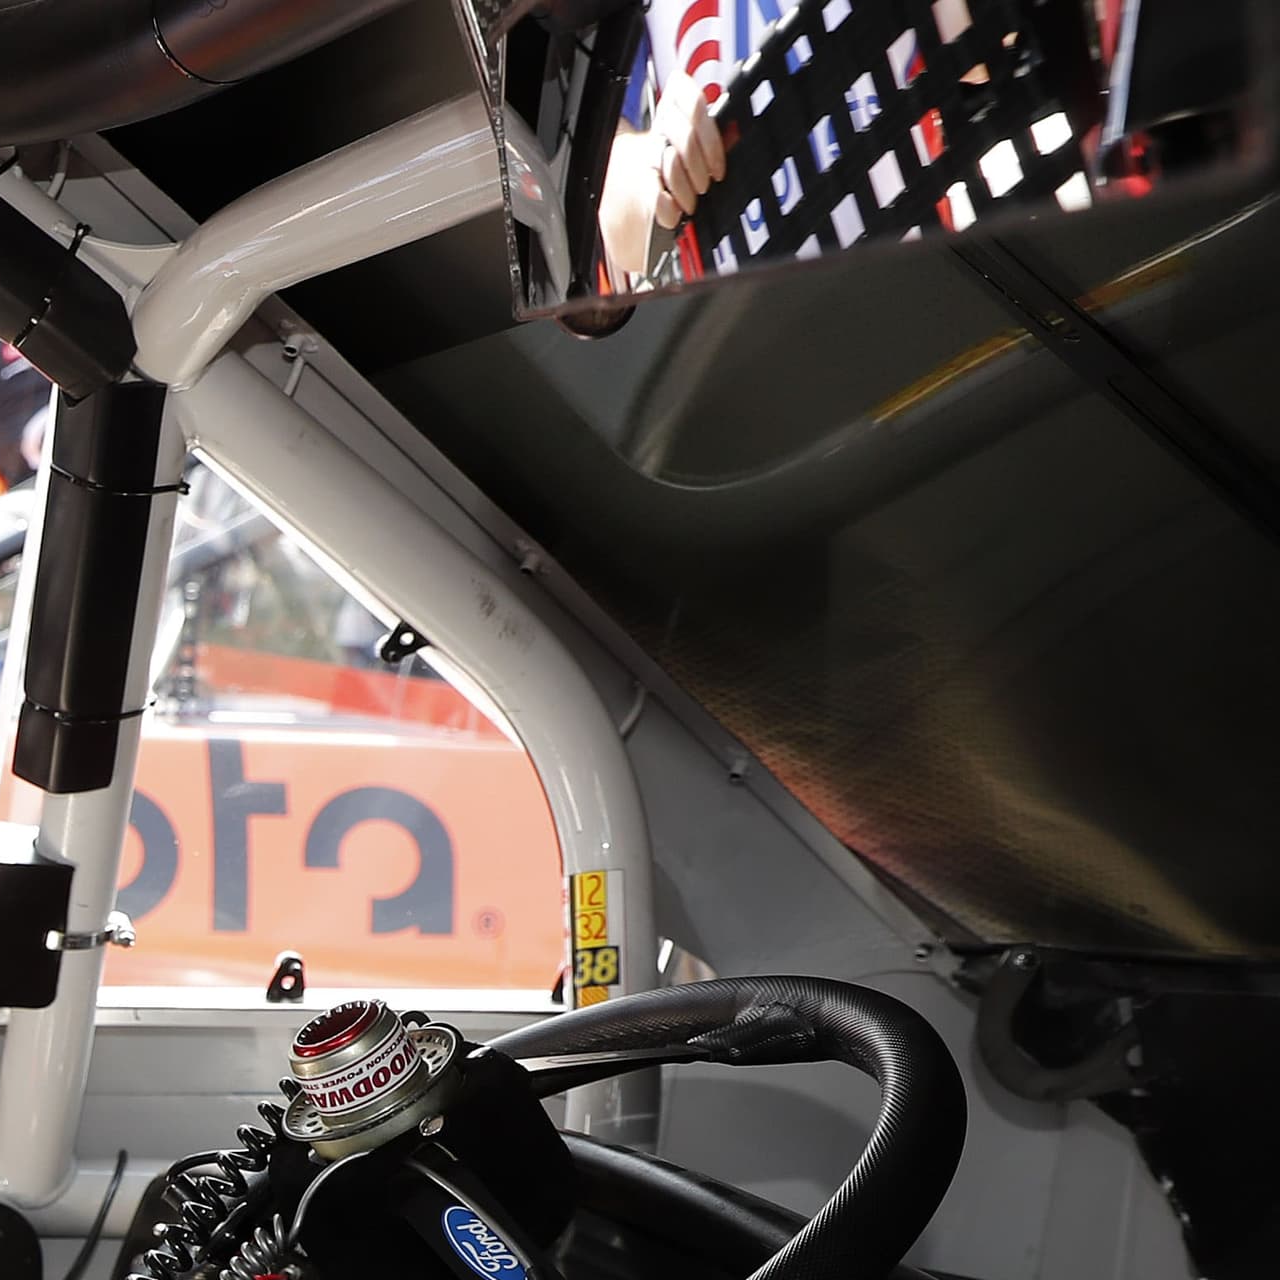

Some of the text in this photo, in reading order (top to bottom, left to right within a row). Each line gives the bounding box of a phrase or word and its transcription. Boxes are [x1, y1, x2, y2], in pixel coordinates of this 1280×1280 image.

[579, 874, 603, 906] 12
[578, 911, 608, 941] 32
[575, 947, 618, 987] 38
[322, 1066, 366, 1089] POWER
